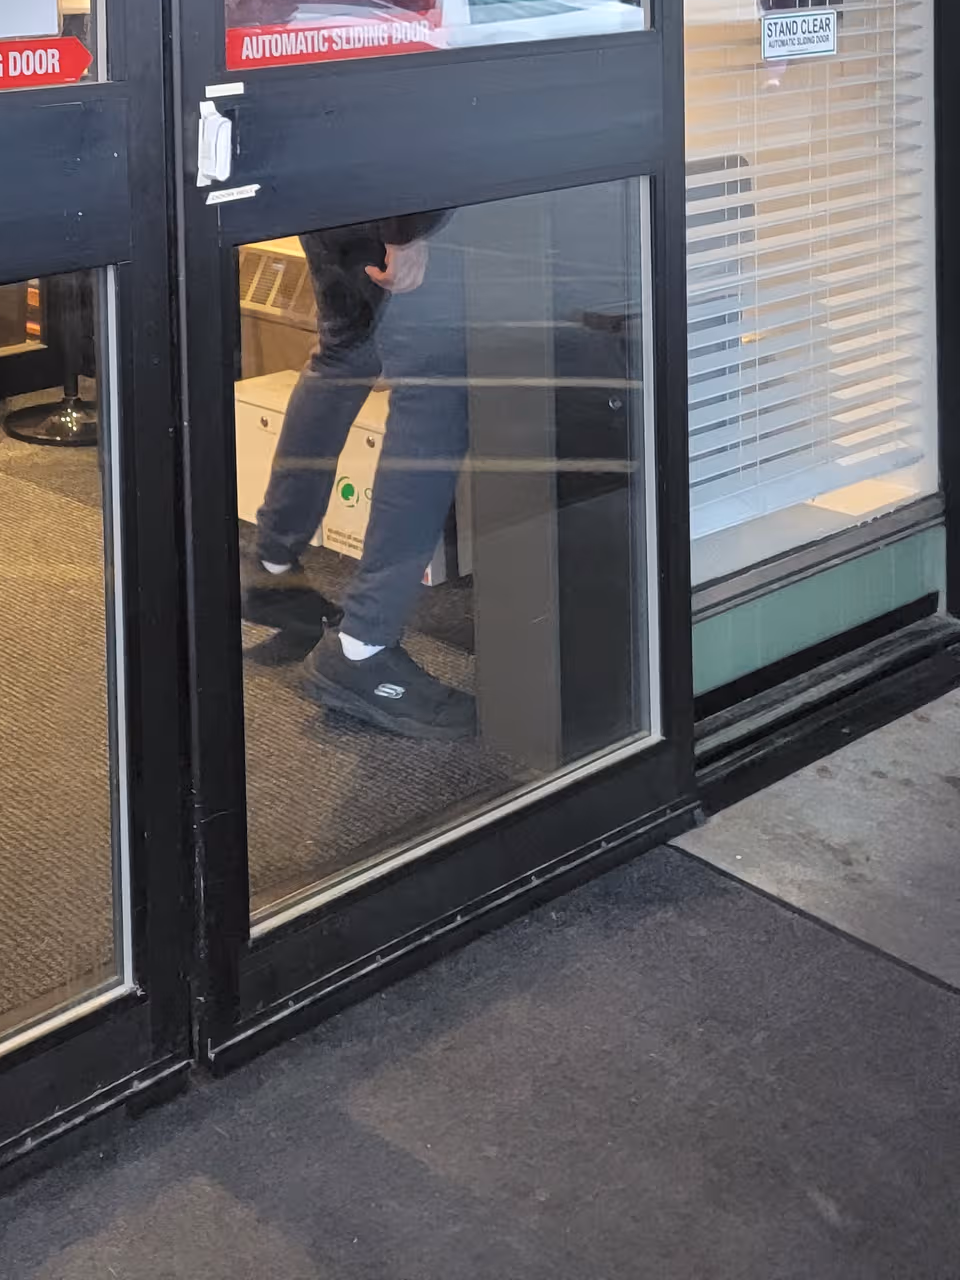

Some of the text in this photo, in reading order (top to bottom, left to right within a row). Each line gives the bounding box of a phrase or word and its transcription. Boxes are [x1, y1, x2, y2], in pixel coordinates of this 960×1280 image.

[767, 17, 831, 38] STAND CLEAR
[241, 20, 431, 60] AUTOMATIC SLIDING DOOR
[768, 34, 830, 48] AUTOMATIC SLIDING DOOR
[8, 48, 61, 76] DOOR
